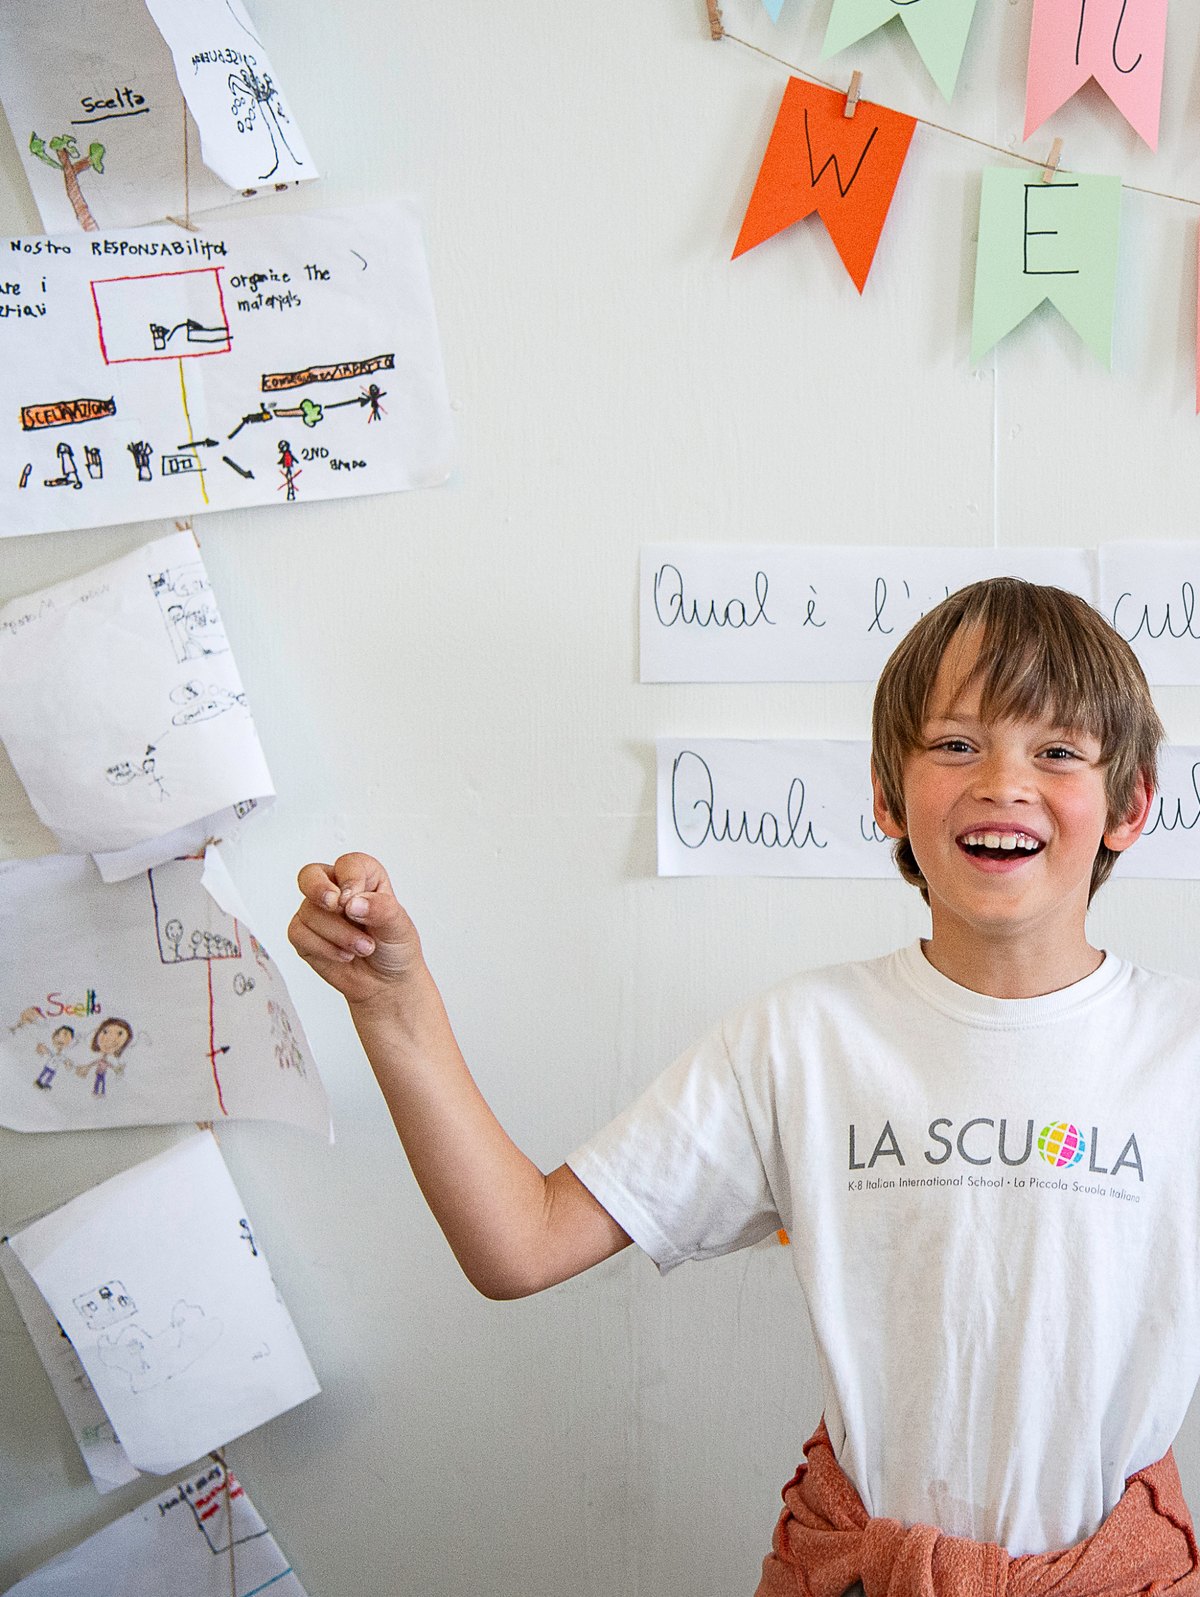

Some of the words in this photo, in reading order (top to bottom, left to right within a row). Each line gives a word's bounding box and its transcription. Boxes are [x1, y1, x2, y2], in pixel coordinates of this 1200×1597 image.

[653, 564, 777, 628] Qual
[802, 585, 827, 628] è
[671, 750, 828, 850] Quali
[849, 1119, 906, 1170] LA
[866, 1177, 895, 1189] Italian
[899, 1175, 963, 1188] International
[967, 1175, 1004, 1189] School
[1014, 1177, 1025, 1188] La
[1029, 1177, 1068, 1191] Piccola
[1072, 1181, 1106, 1196] Scuola
[1109, 1187, 1140, 1203] Italiana
